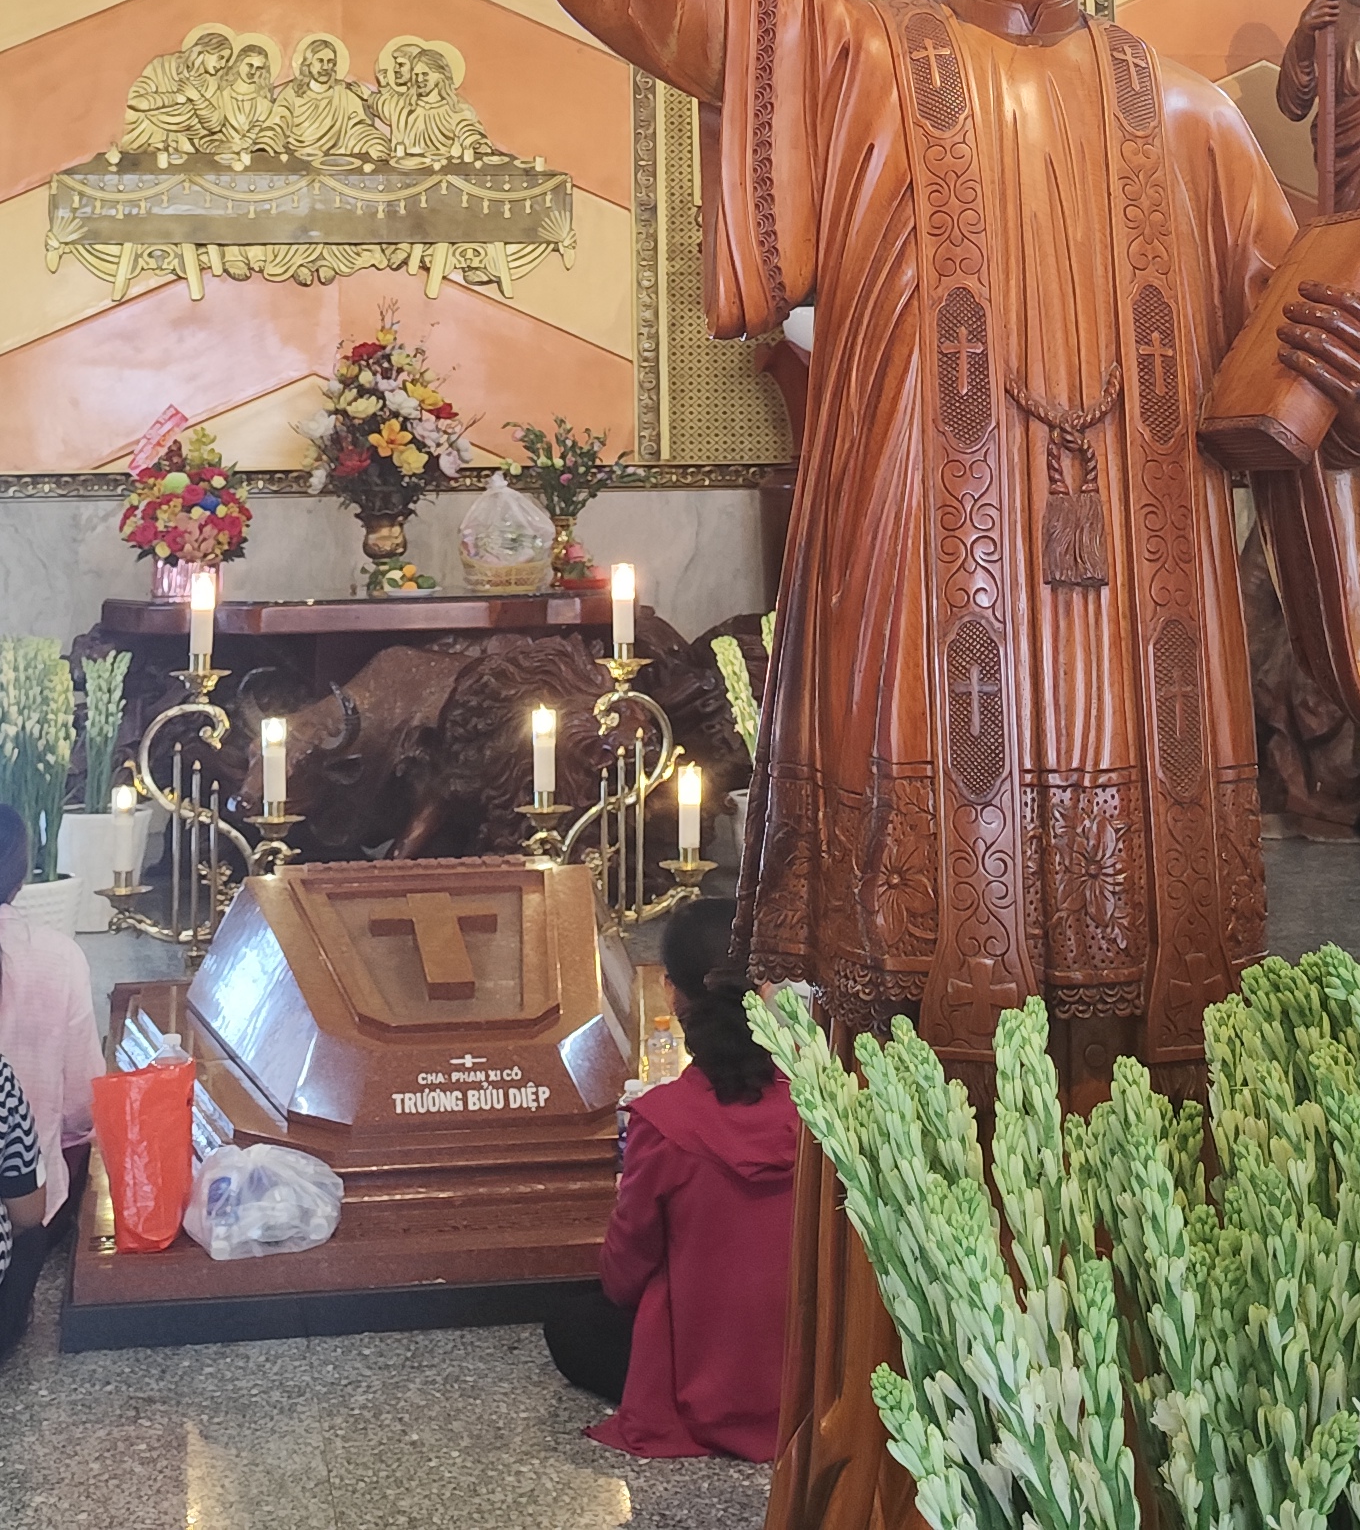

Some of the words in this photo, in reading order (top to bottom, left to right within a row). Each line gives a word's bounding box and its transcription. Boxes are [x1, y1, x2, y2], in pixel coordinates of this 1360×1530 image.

[451, 1070, 486, 1083] PHAN
[391, 1087, 464, 1114] TRƯƠNG
[467, 1082, 505, 1111] BỬU
[508, 1081, 551, 1112] DIỆP
